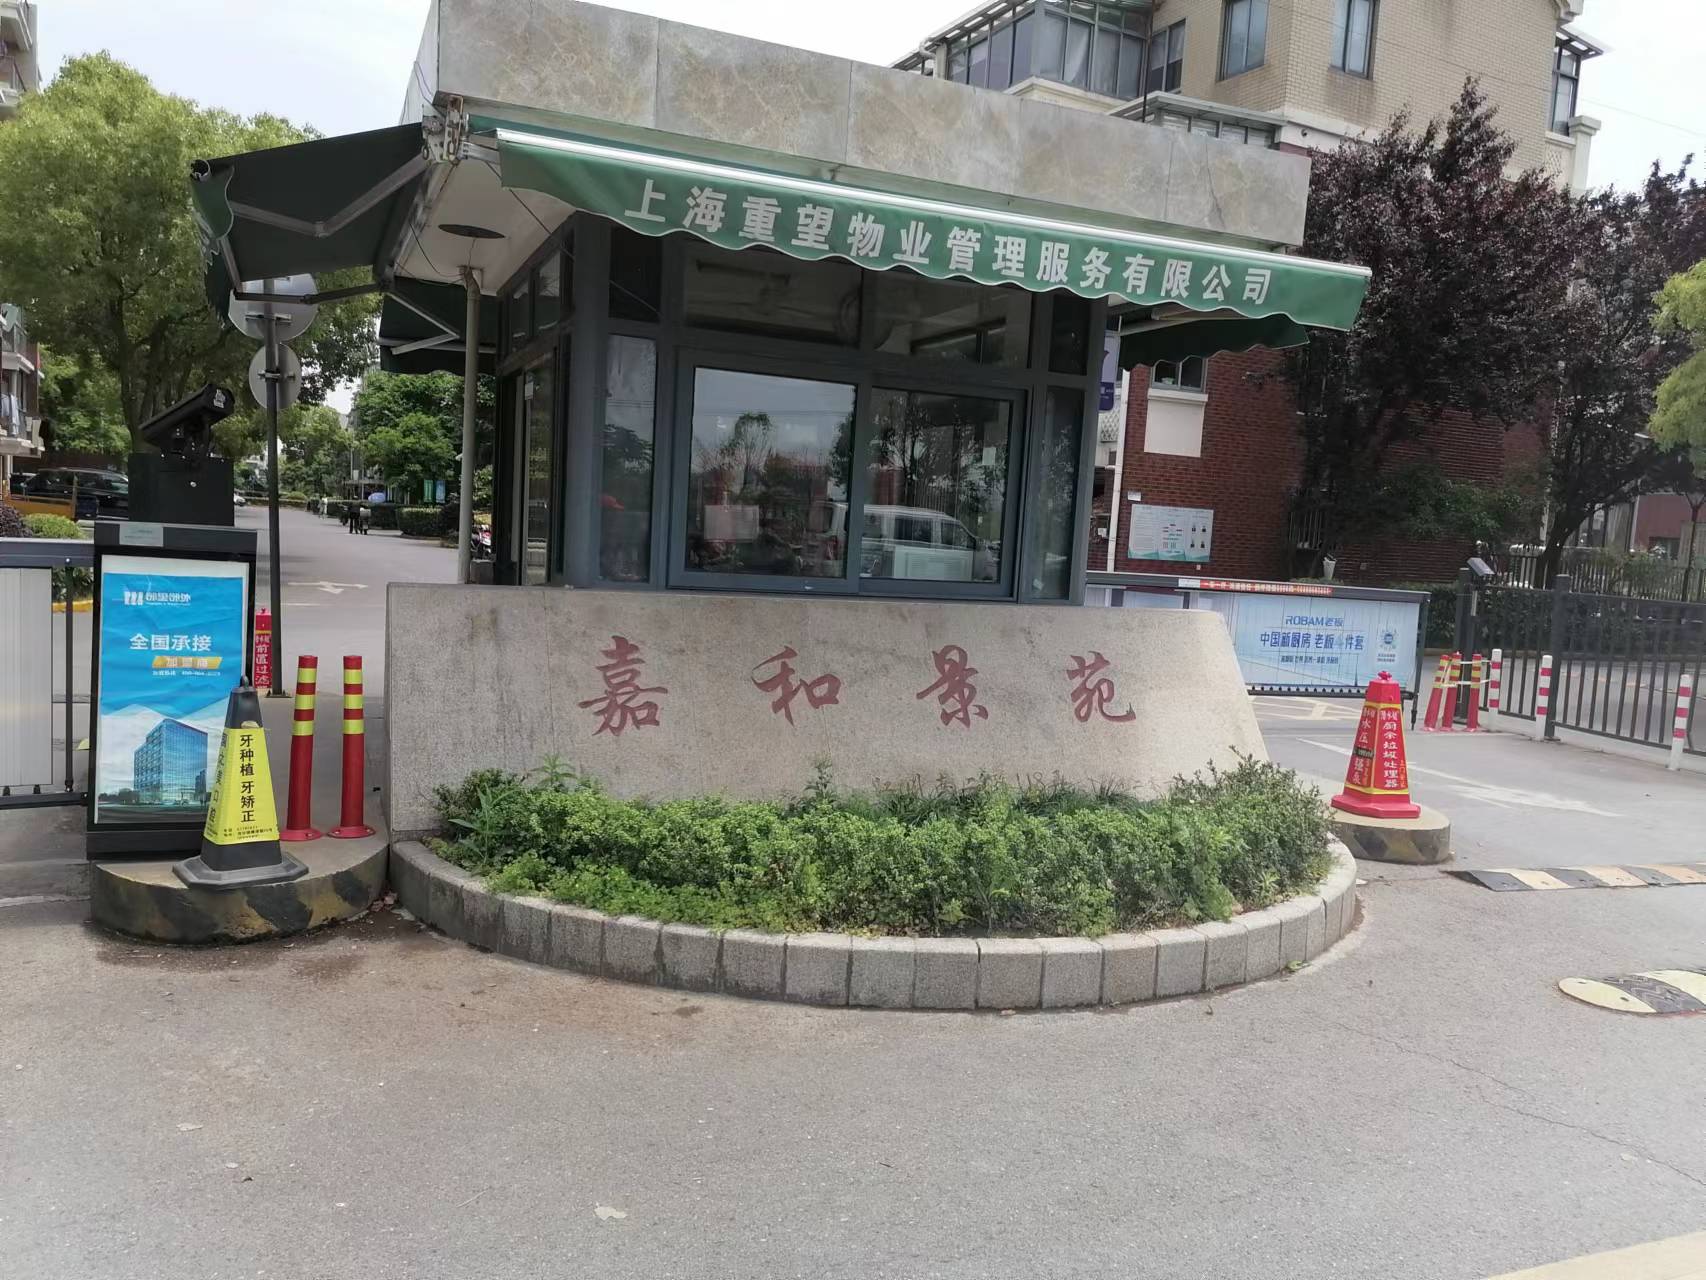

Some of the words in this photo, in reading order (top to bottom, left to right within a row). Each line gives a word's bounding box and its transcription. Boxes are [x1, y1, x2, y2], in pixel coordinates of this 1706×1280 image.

[625, 179, 1271, 305] 上海重望物业管理服务有限公司
[129, 633, 212, 652] 全国承接
[1260, 631, 1312, 648] 中国新厨房
[1285, 615, 1324, 627] ROBAM
[255, 644, 270, 689] 前置过滤
[578, 635, 1136, 736] 嘉和景苑
[239, 734, 255, 777] 牙种植
[1383, 721, 1399, 788] 厨余垃圾处理器
[241, 780, 256, 823] 牙矫正
